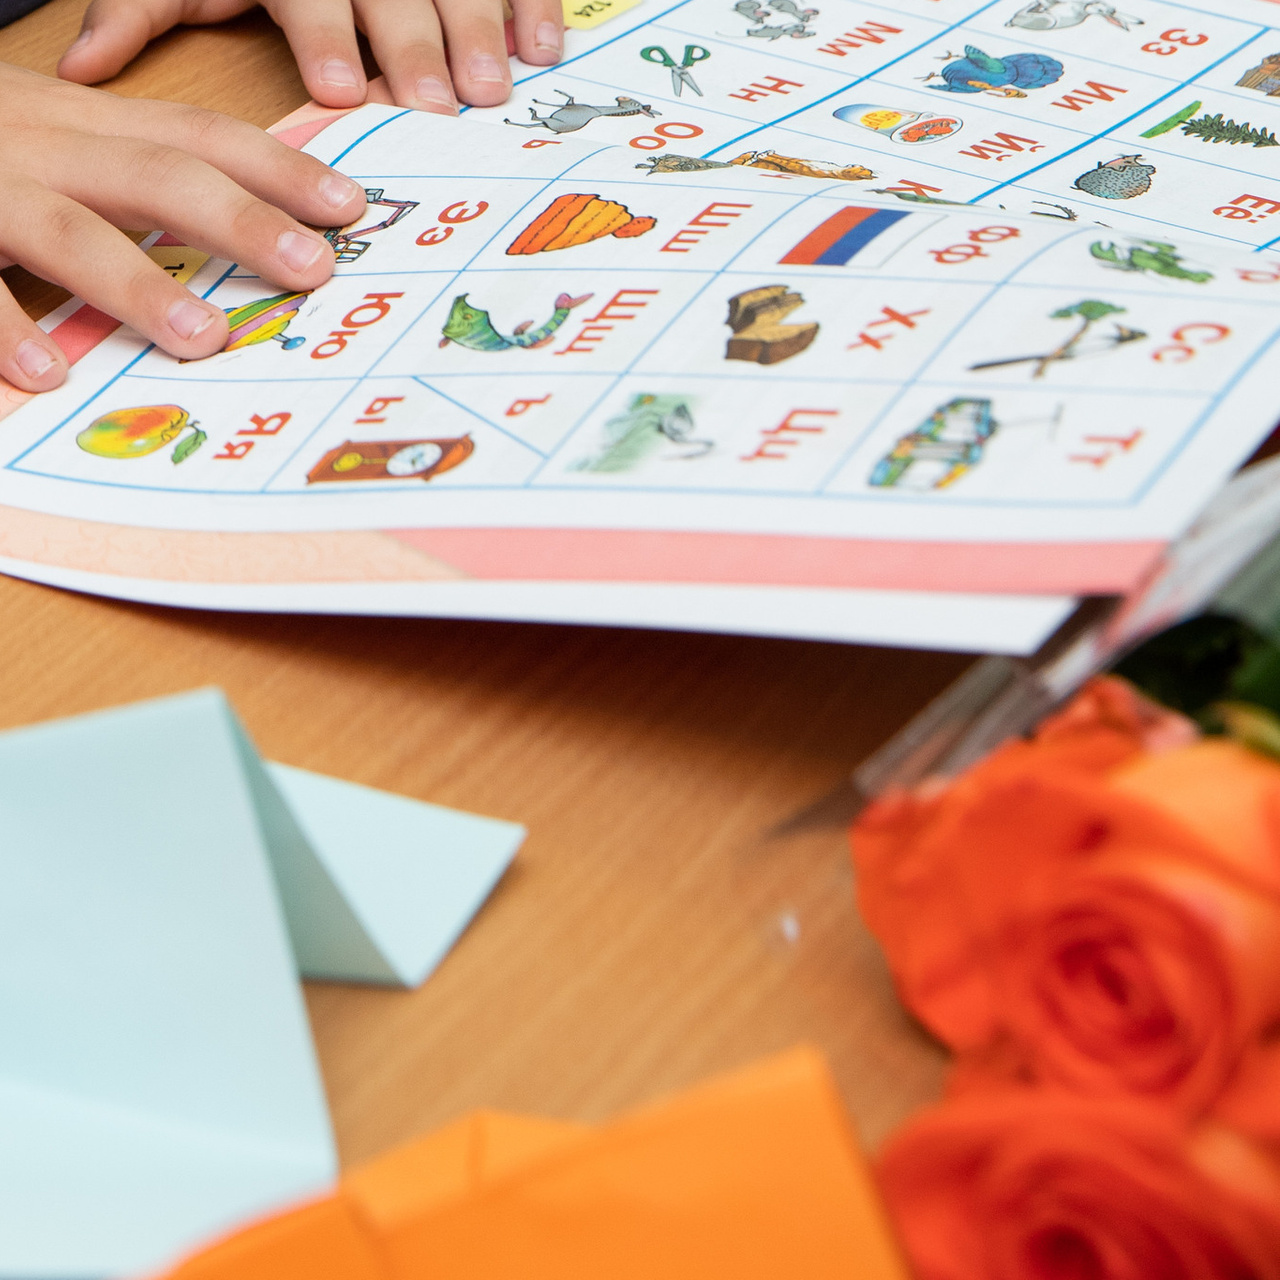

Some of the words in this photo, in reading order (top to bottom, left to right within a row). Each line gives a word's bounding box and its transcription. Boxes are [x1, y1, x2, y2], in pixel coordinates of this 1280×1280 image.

[567, 0, 612, 18] 124
[818, 21, 903, 57] Мм
[1141, 28, 1209, 56] Зз
[729, 76, 804, 103] Нн
[1052, 81, 1128, 112] Ии
[628, 122, 705, 151] Оо
[959, 132, 1044, 162] Йй
[415, 201, 489, 247] Ээ
[659, 202, 753, 253] Шш
[1212, 194, 1280, 224] Ёё
[928, 225, 1022, 265] Фф
[310, 292, 405, 360] Юю
[553, 289, 660, 356] Щщ
[848, 306, 930, 352] Хх
[1152, 323, 1232, 363] Сс
[355, 397, 405, 425] ы
[213, 412, 292, 461] Яя
[740, 409, 841, 462] Цц
[1066, 428, 1145, 467] Тт
